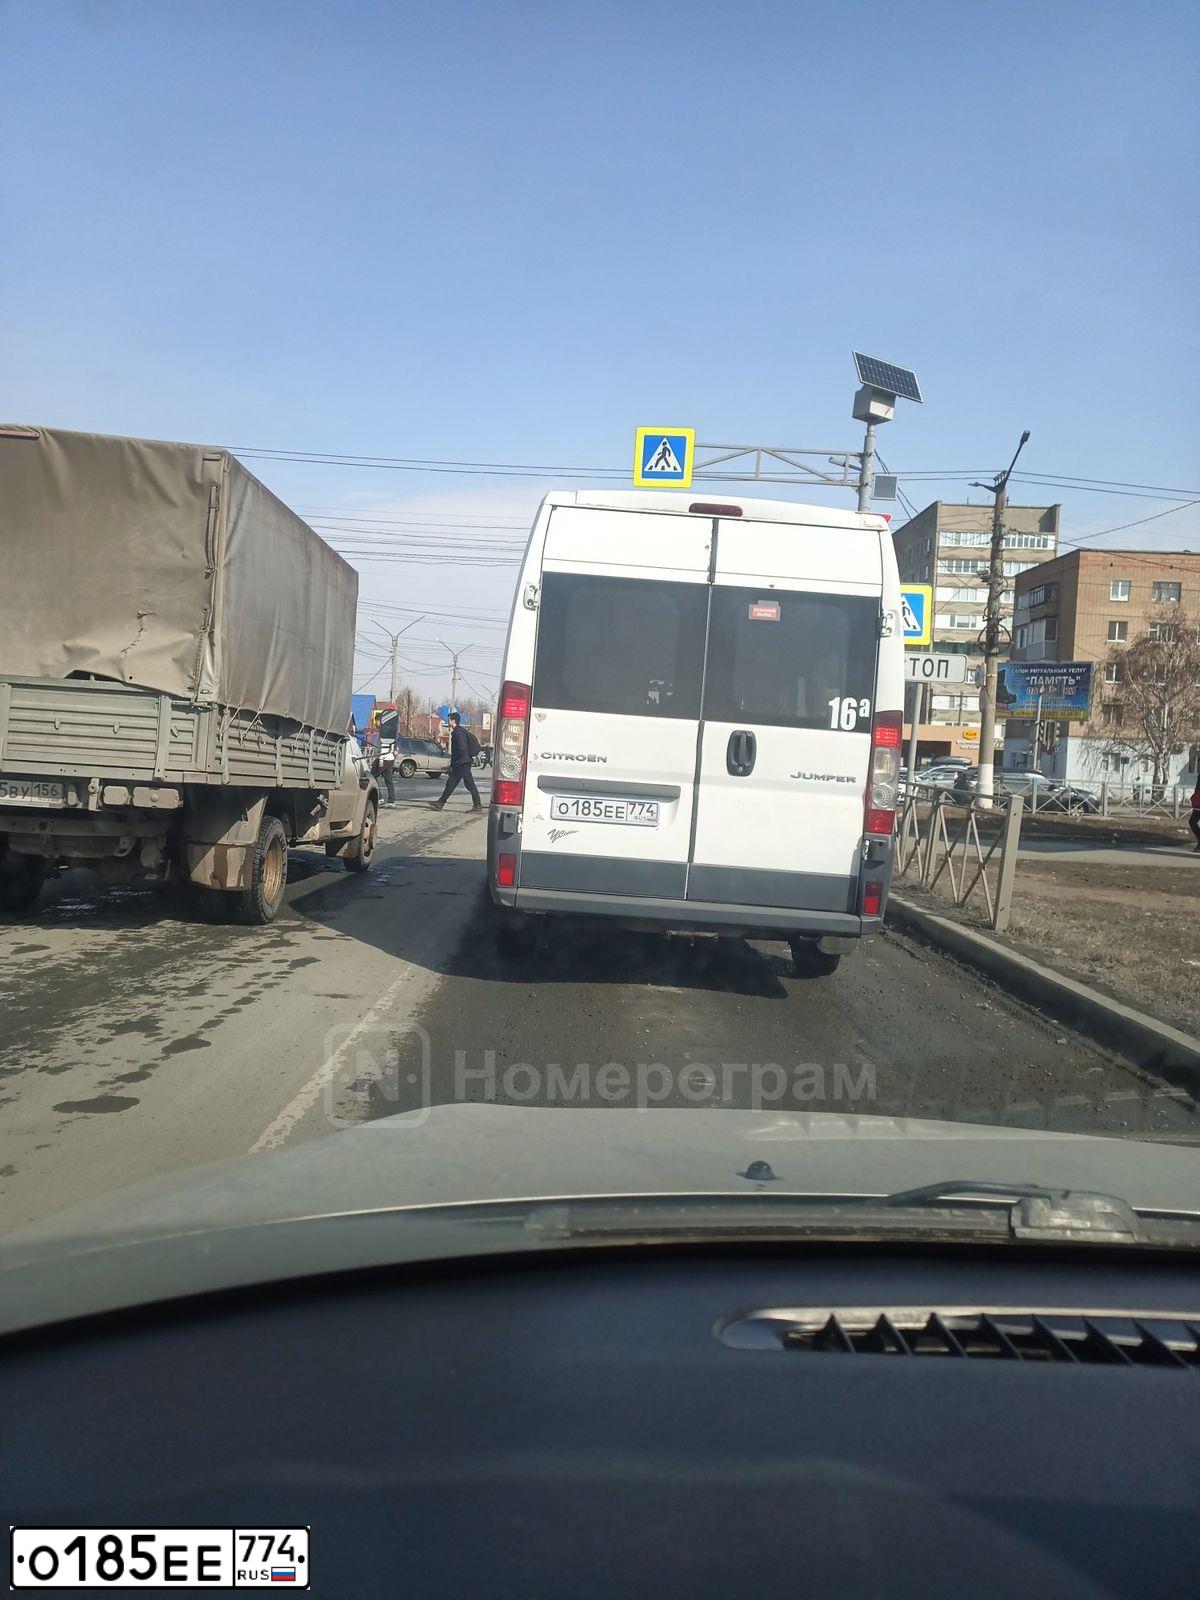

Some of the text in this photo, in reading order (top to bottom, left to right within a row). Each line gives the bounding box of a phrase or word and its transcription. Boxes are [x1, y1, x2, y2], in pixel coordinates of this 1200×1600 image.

[904, 658, 949, 678] ТОП
[541, 752, 607, 763] CITROËN
[790, 771, 856, 783] JUMPER
[34, 784, 57, 796] 156
[558, 800, 654, 819] О185ЕЕ 774
